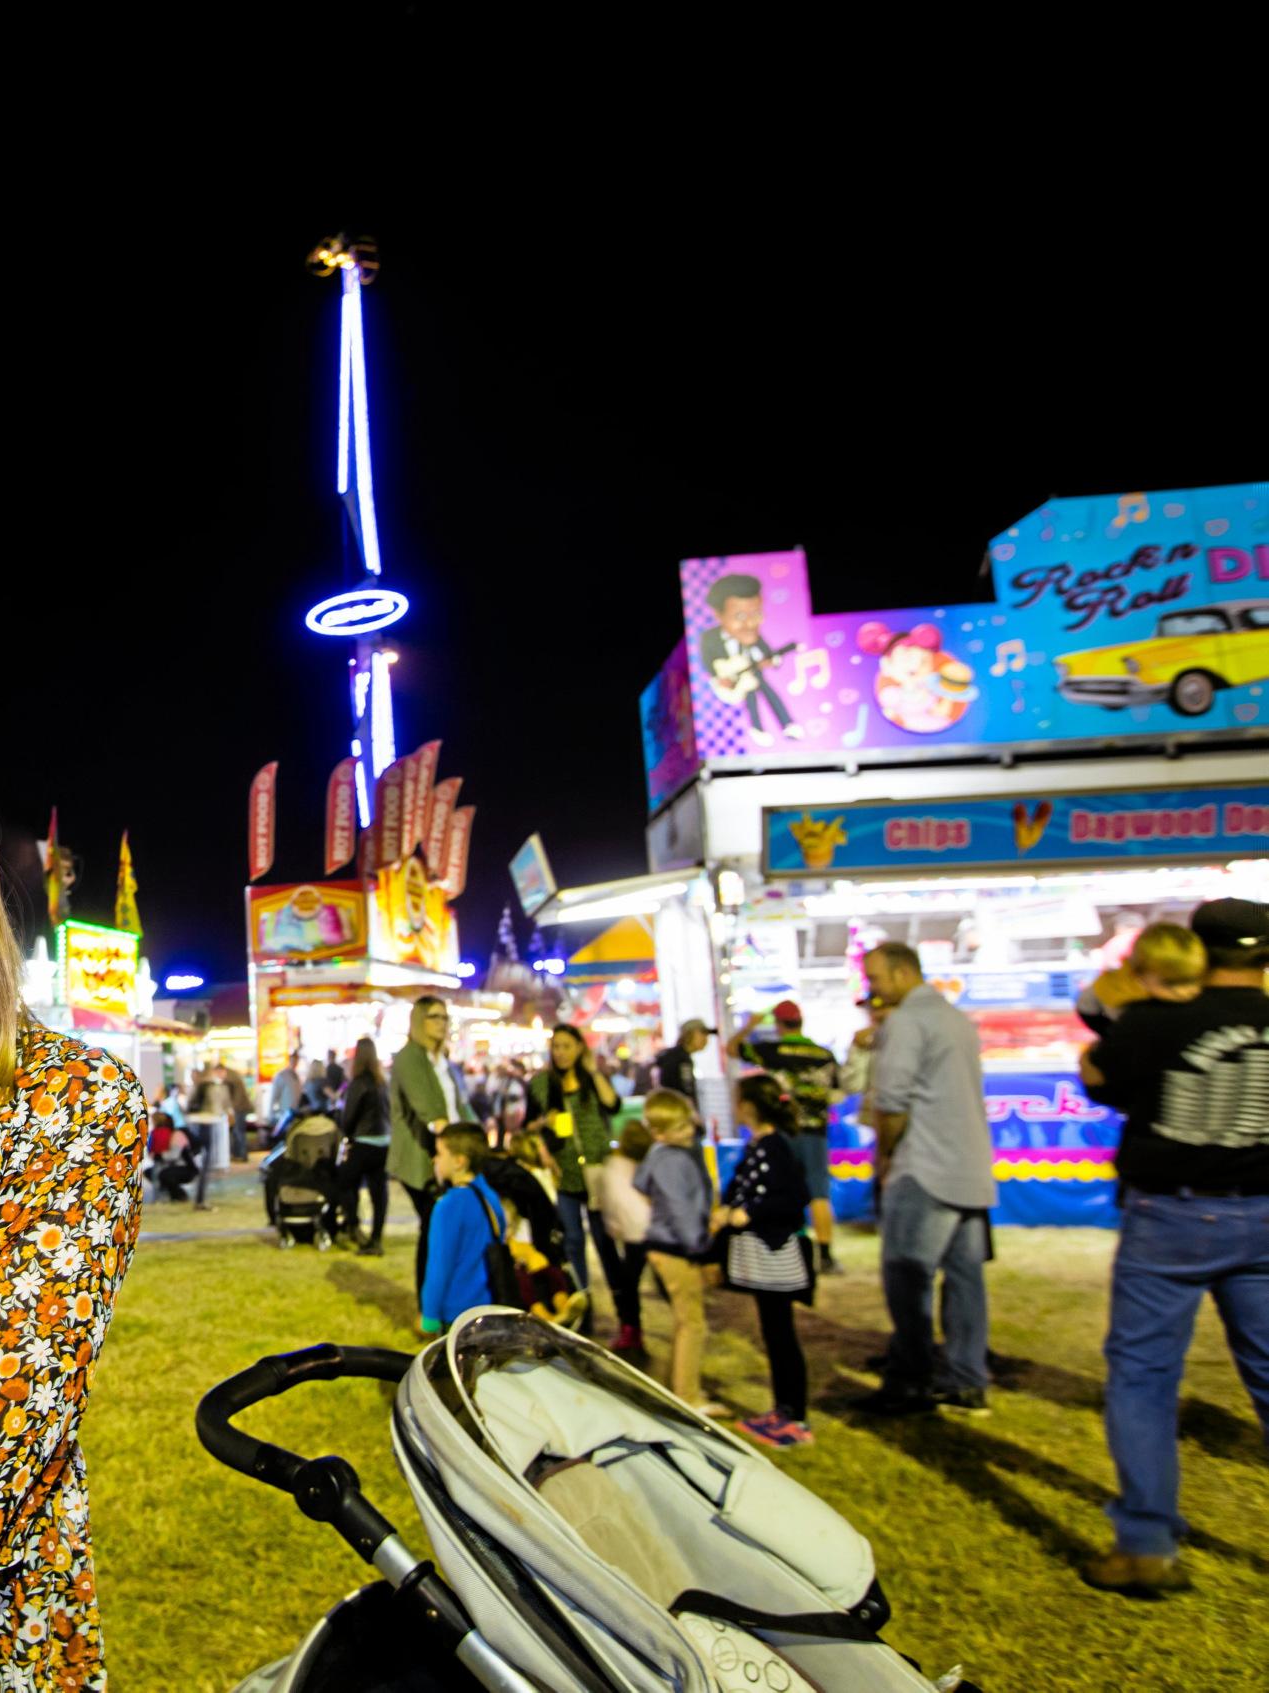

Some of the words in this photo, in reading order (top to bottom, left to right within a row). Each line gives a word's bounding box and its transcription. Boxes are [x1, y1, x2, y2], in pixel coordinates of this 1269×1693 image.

[1011, 543, 1163, 610] Rock
[1062, 573, 1192, 632] Roll
[256, 791, 270, 835] FOOD
[335, 783, 352, 828] FOOD
[1069, 803, 1217, 843] Dagwood
[1223, 802, 1269, 837] Do
[885, 817, 971, 852] Chips
[984, 1080, 1109, 1122] ock
